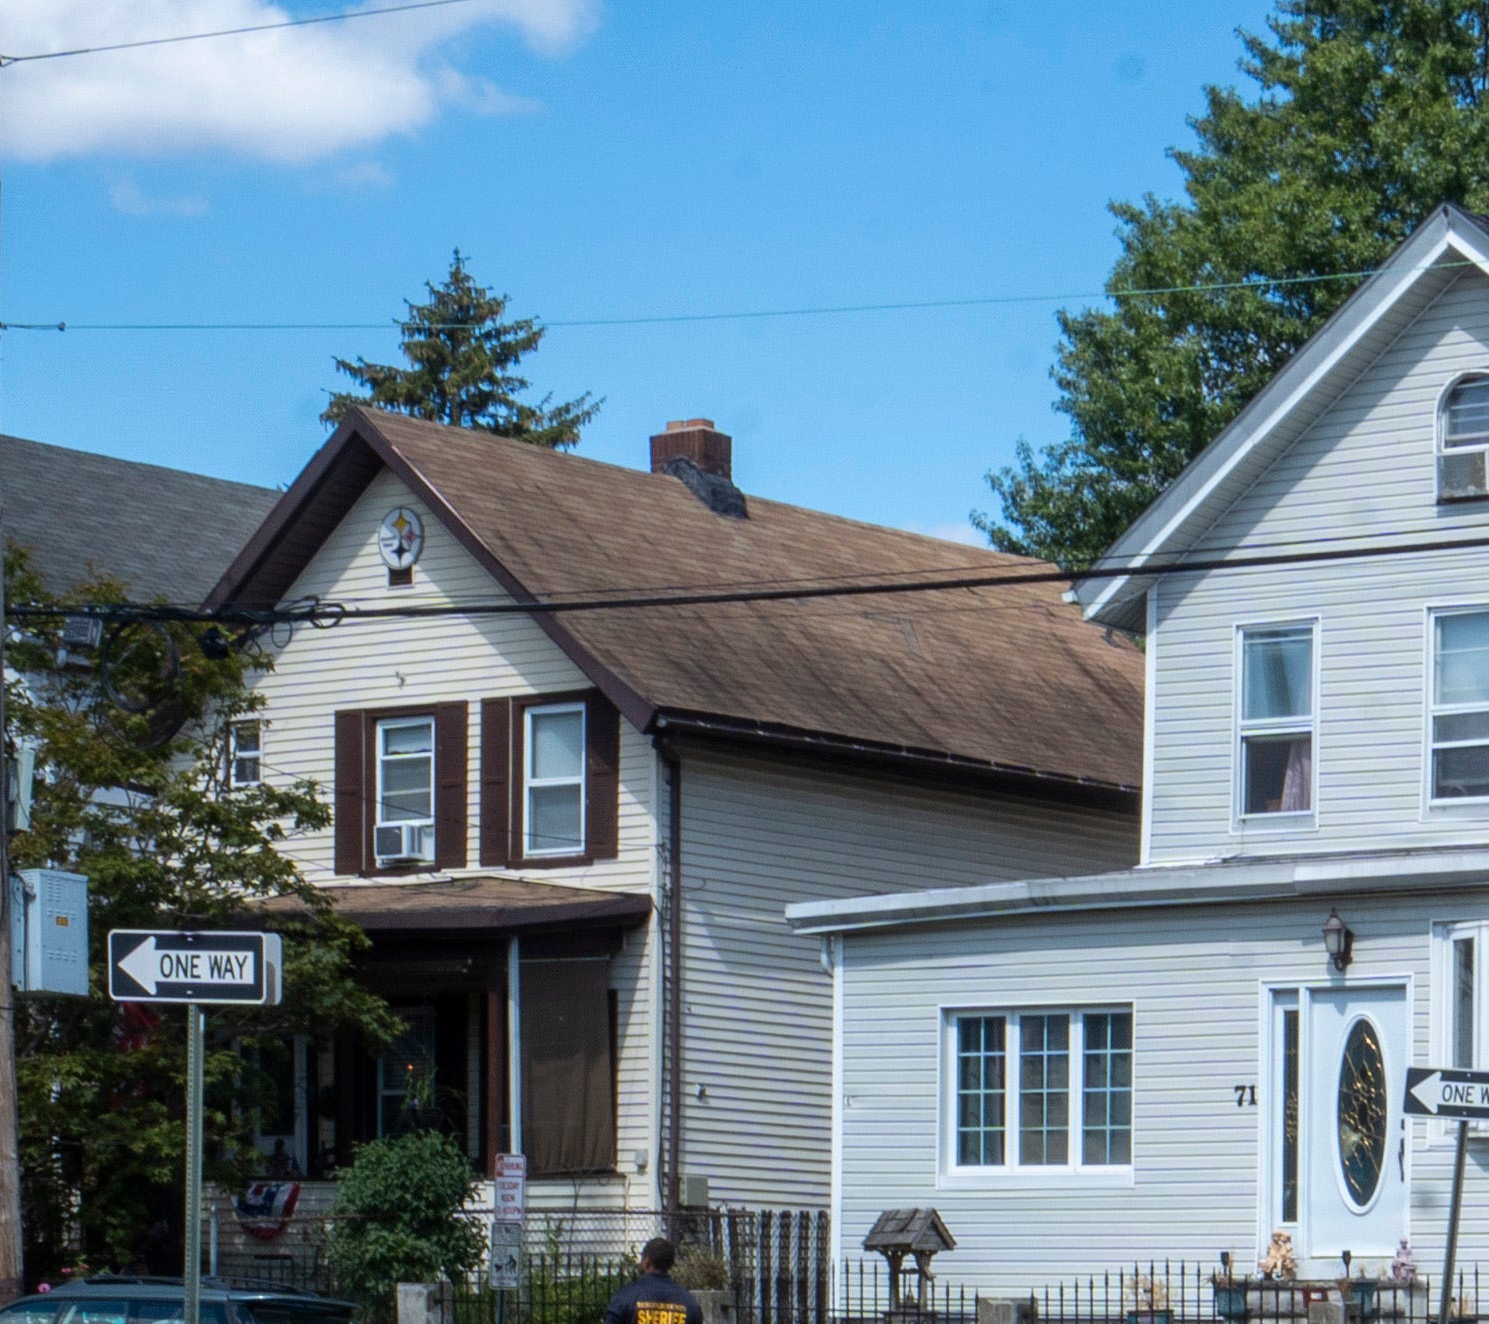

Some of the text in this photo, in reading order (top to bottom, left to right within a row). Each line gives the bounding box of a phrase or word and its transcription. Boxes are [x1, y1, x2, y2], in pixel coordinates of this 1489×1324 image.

[160, 954, 248, 980] ONE WAY
[1234, 1085, 1256, 1107] 71
[1441, 1084, 1474, 1104] ONE
